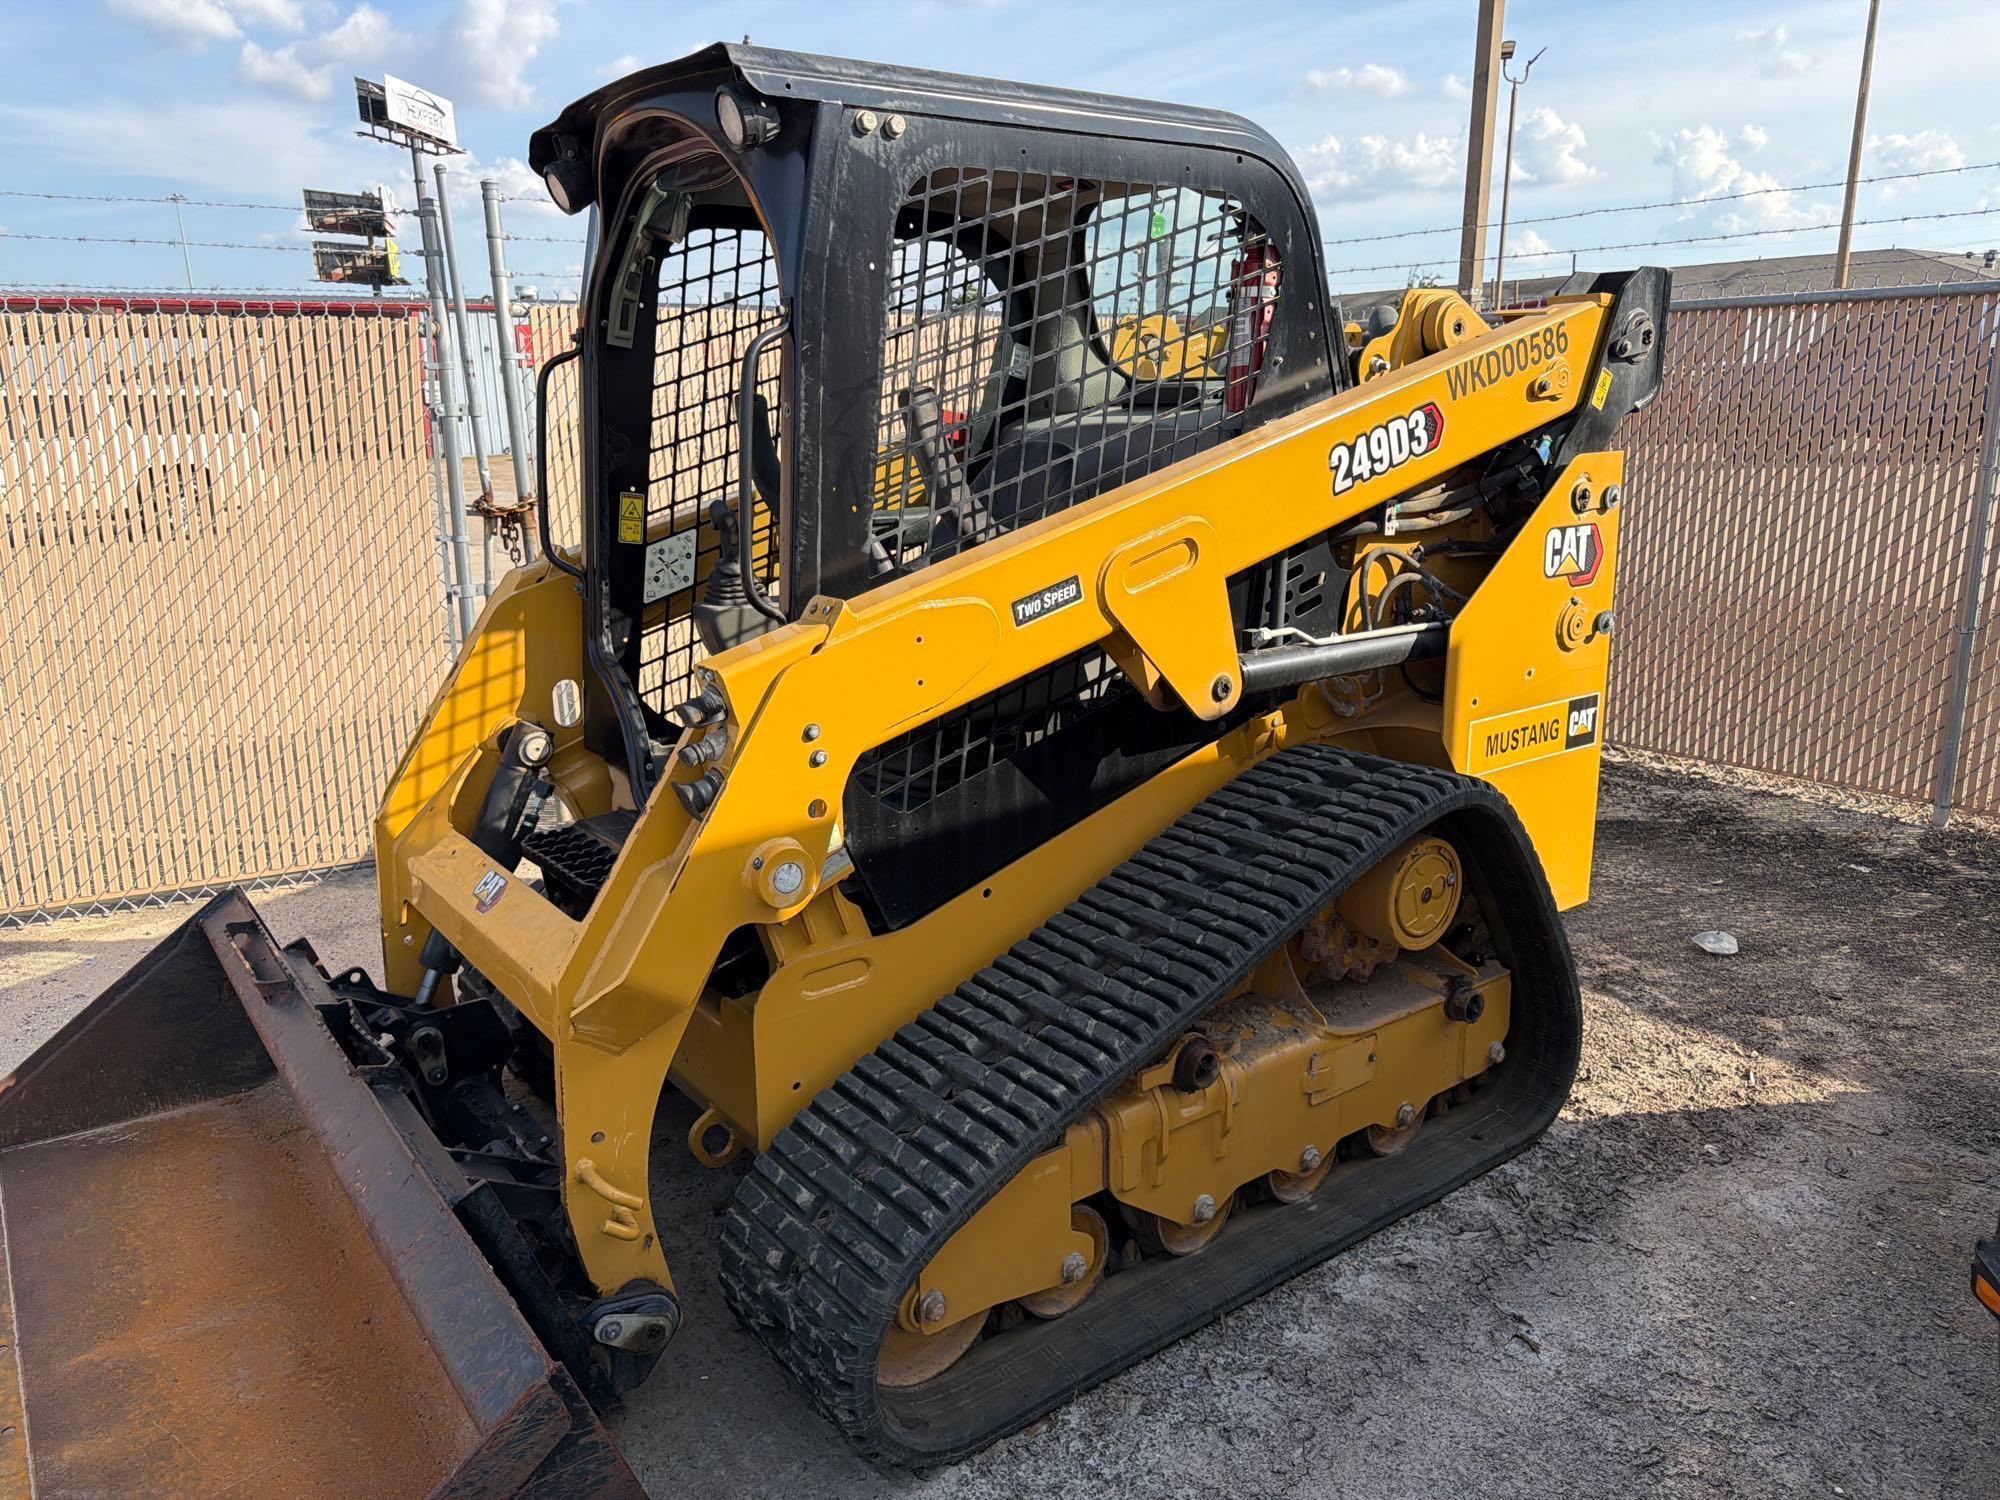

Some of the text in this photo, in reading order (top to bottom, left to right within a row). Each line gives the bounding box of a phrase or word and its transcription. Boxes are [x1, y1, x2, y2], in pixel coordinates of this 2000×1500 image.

[1446, 321, 1569, 401] WKD00586
[1330, 409, 1429, 494] 249D3
[1545, 524, 1592, 577] CAT
[1485, 707, 1597, 757] MUSTANG CAT
[474, 870, 506, 904] CAT
